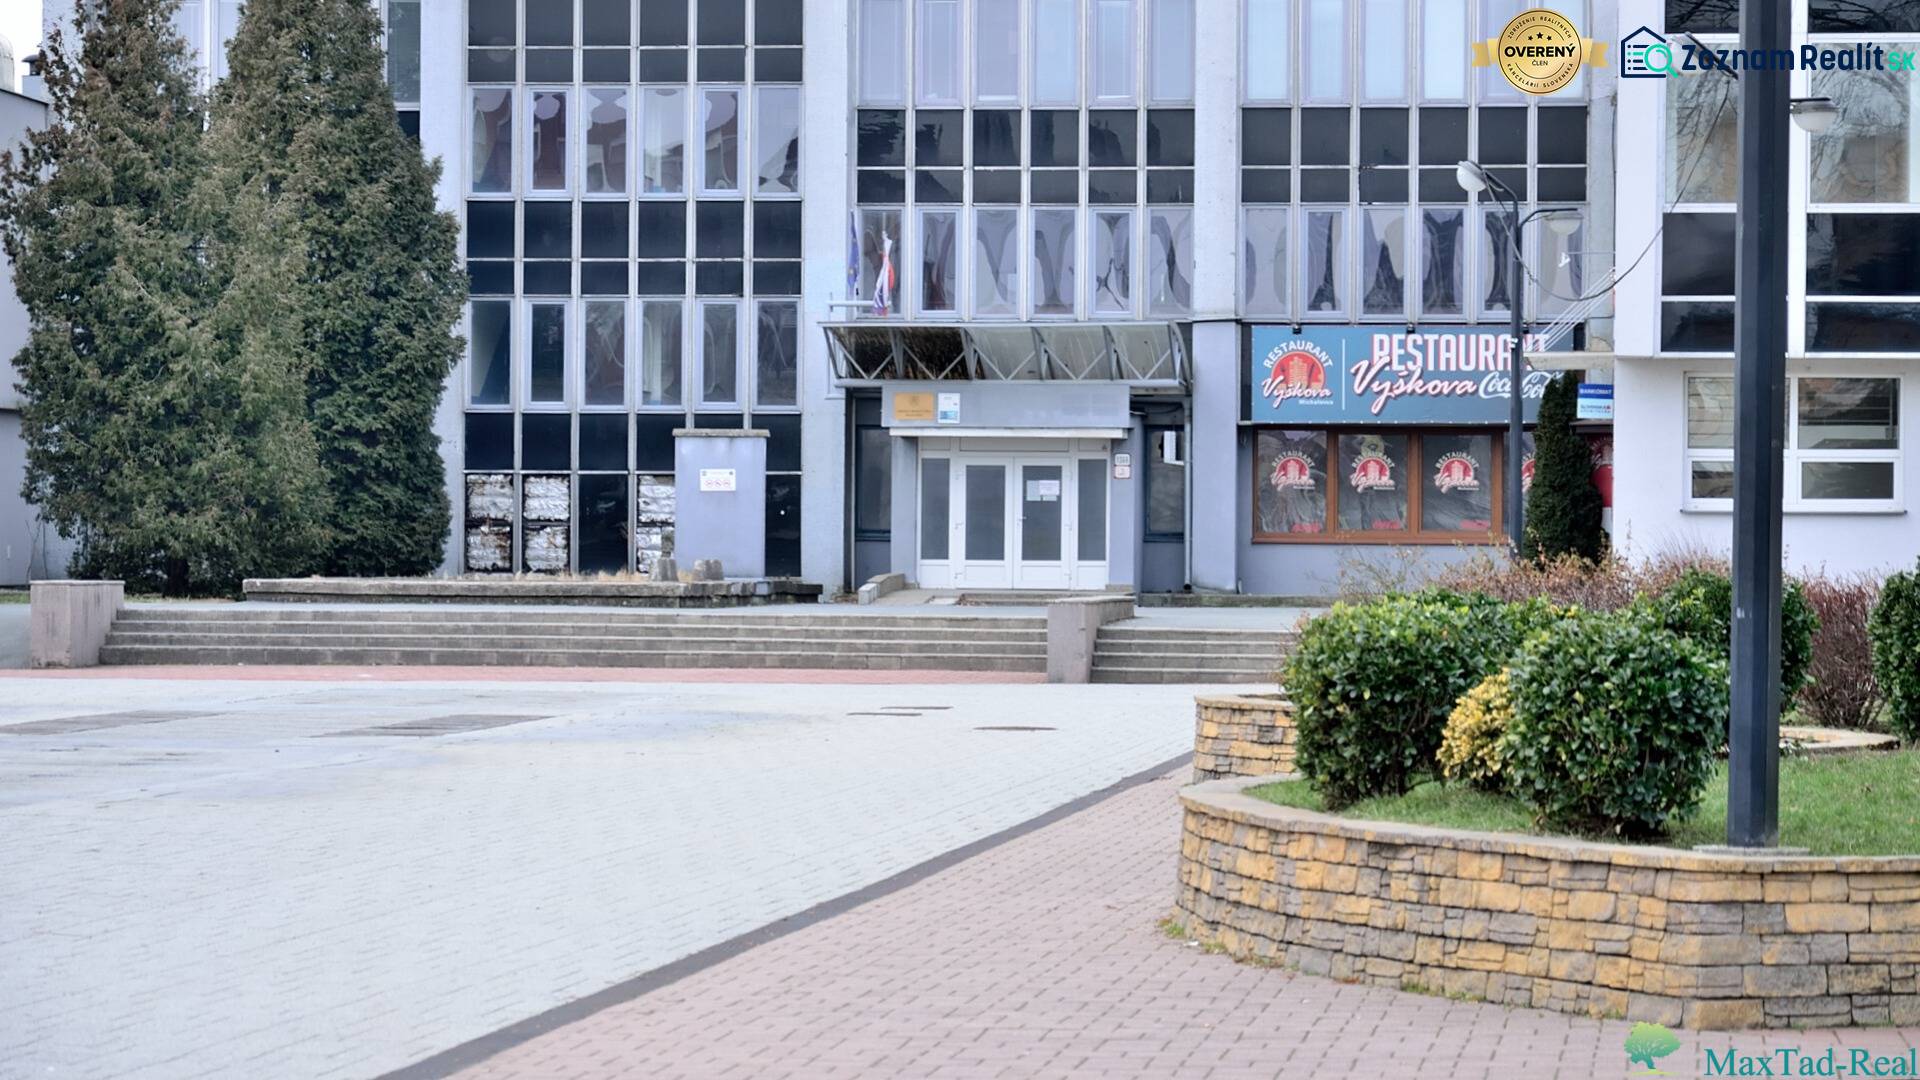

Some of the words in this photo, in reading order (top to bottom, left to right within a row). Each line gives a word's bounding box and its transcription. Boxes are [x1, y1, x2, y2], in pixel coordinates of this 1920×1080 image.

[1263, 340, 1333, 368] RESTAURANT
[1372, 333, 1549, 372] RESTAURAT
[1261, 375, 1333, 409] Vyškova
[1350, 355, 1478, 415] Vyškova
